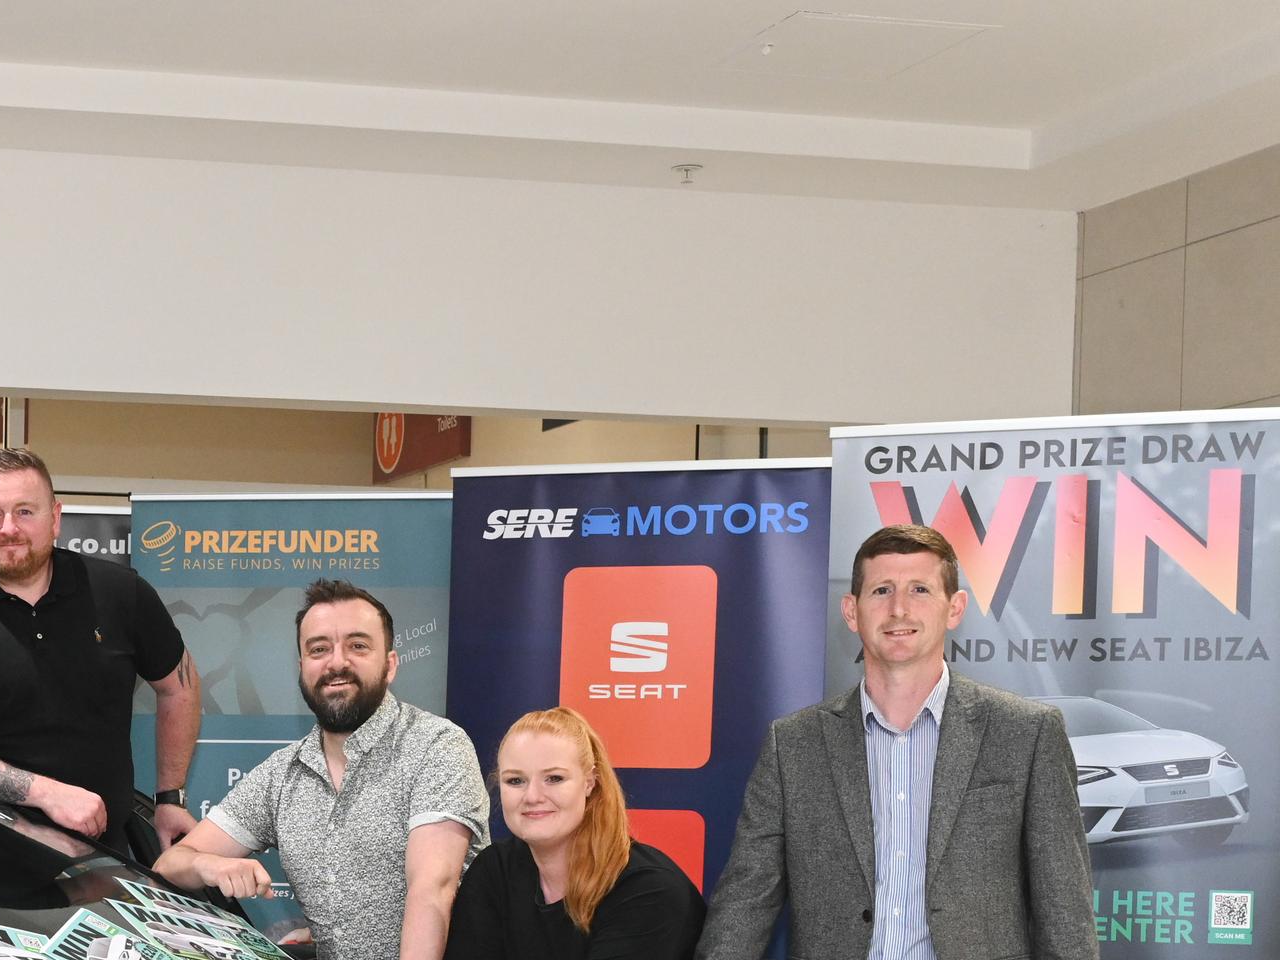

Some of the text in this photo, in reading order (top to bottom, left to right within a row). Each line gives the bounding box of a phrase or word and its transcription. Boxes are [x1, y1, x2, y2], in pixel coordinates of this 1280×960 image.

[437, 415, 457, 433] Toilets
[864, 430, 1266, 474] GRAND PRIZE DRAW
[483, 502, 808, 540] SERE MOTORS
[184, 529, 379, 553] PRIZEFUNDER
[869, 468, 1252, 618] WIN
[183, 557, 380, 571] RAISE FUNDS, WIN PRIZES
[406, 619, 437, 643] Local
[1008, 638, 1078, 663] NEW
[1089, 637, 1171, 662] SEAT
[1184, 637, 1270, 662] IBIZA
[589, 684, 687, 699] SEAT
[1113, 890, 1195, 917] HERE
[116, 902, 216, 939] WIN
[1095, 917, 1194, 944] ENTER
